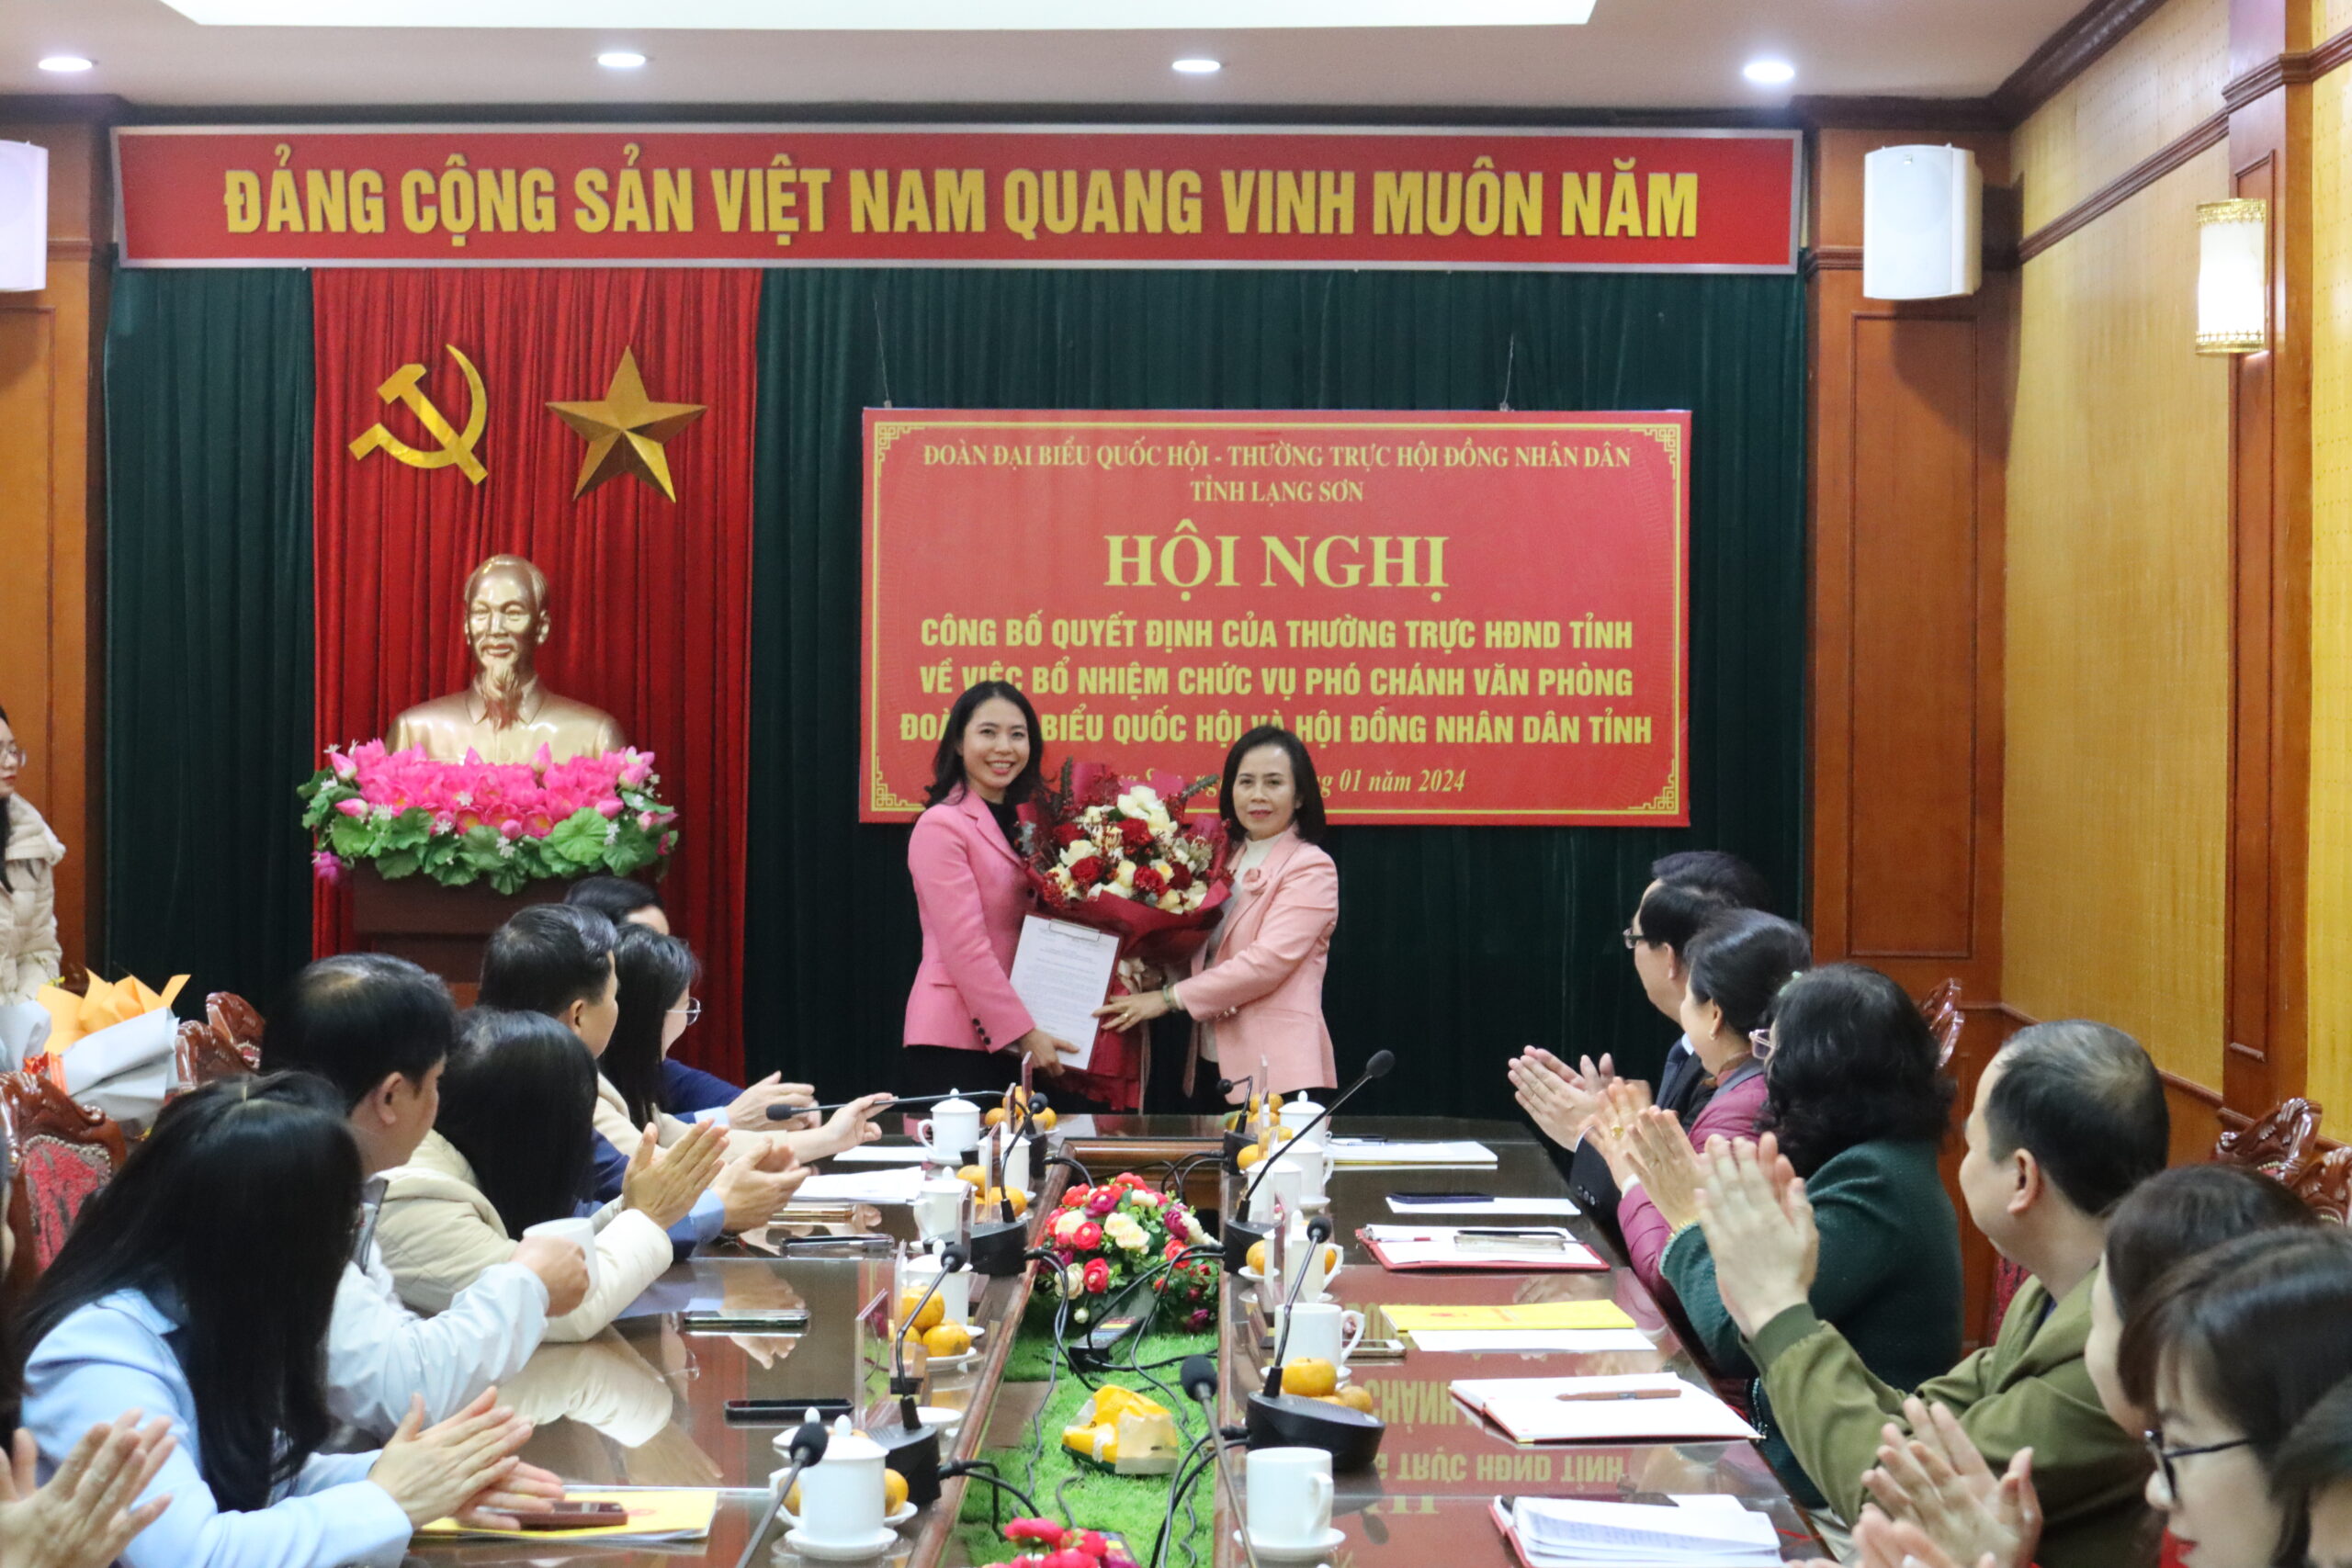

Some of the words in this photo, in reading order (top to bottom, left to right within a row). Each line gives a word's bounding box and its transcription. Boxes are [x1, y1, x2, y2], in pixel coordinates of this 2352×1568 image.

[224, 145, 384, 233] ĐẢNG
[401, 155, 556, 246] CỘNG
[574, 145, 694, 232] SẢN
[711, 155, 831, 245] VIỆT
[850, 171, 985, 232] NAM
[1004, 170, 1202, 240] QUANG
[1222, 172, 1355, 234] VINH
[1374, 158, 1543, 236] MUÔN
[1562, 160, 1698, 237] NĂM
[922, 439, 988, 467] ĐOÀN
[992, 445, 1033, 470] ĐẠI
[1038, 435, 1091, 467] BIỂU
[1096, 436, 1161, 470] QUỐC
[1167, 440, 1209, 471] HỘI
[1227, 440, 1324, 468] THƯỜNG
[1329, 444, 1391, 471] TRỰC
[1396, 441, 1438, 472] HỘI
[1442, 437, 1509, 468] ĐỒNG
[1515, 441, 1577, 467] NHÂN
[1584, 441, 1632, 468] DÂN
[1191, 475, 1246, 502] TỈNH
[1251, 480, 1314, 507] LẠNG
[1319, 479, 1363, 502] SƠN
[1105, 519, 1239, 601] HỘI
[1261, 536, 1448, 603] NGHỊ
[922, 614, 997, 647] CÔNG
[1006, 613, 1043, 647] BỐ
[1052, 612, 1137, 649] QUYẾT
[1145, 619, 1213, 653] ĐỊNH
[1222, 612, 1277, 647] CỦA
[1286, 615, 1396, 648] THƯỜNG
[1404, 618, 1476, 654] TRỰC
[1486, 621, 1560, 648] HĐND
[1569, 613, 1632, 649] TỈNH
[921, 659, 952, 694] VỀ
[1032, 657, 1069, 694] BỔ
[1078, 661, 1169, 700] NHIỆM
[1178, 660, 1252, 695] CHỨC
[1261, 669, 1296, 701] VỤ
[1306, 662, 1361, 695] PHÓ
[1371, 664, 1464, 695] CHÁNH
[1474, 664, 1529, 695] VĂN
[1539, 663, 1633, 695] PHÒNG
[1041, 705, 1103, 741] BIỂU
[1113, 705, 1187, 745] QUỐC
[1196, 709, 1242, 748] HỘI
[1295, 710, 1341, 749] HỘI
[1350, 707, 1427, 742] ĐỒNG
[1436, 711, 1513, 742] NHÂN
[1523, 711, 1579, 743] DÂN
[1589, 707, 1653, 744] TỈNH
[1339, 770, 1363, 792] 01
[1368, 772, 1411, 792] năm
[1418, 769, 1466, 792] 2024
